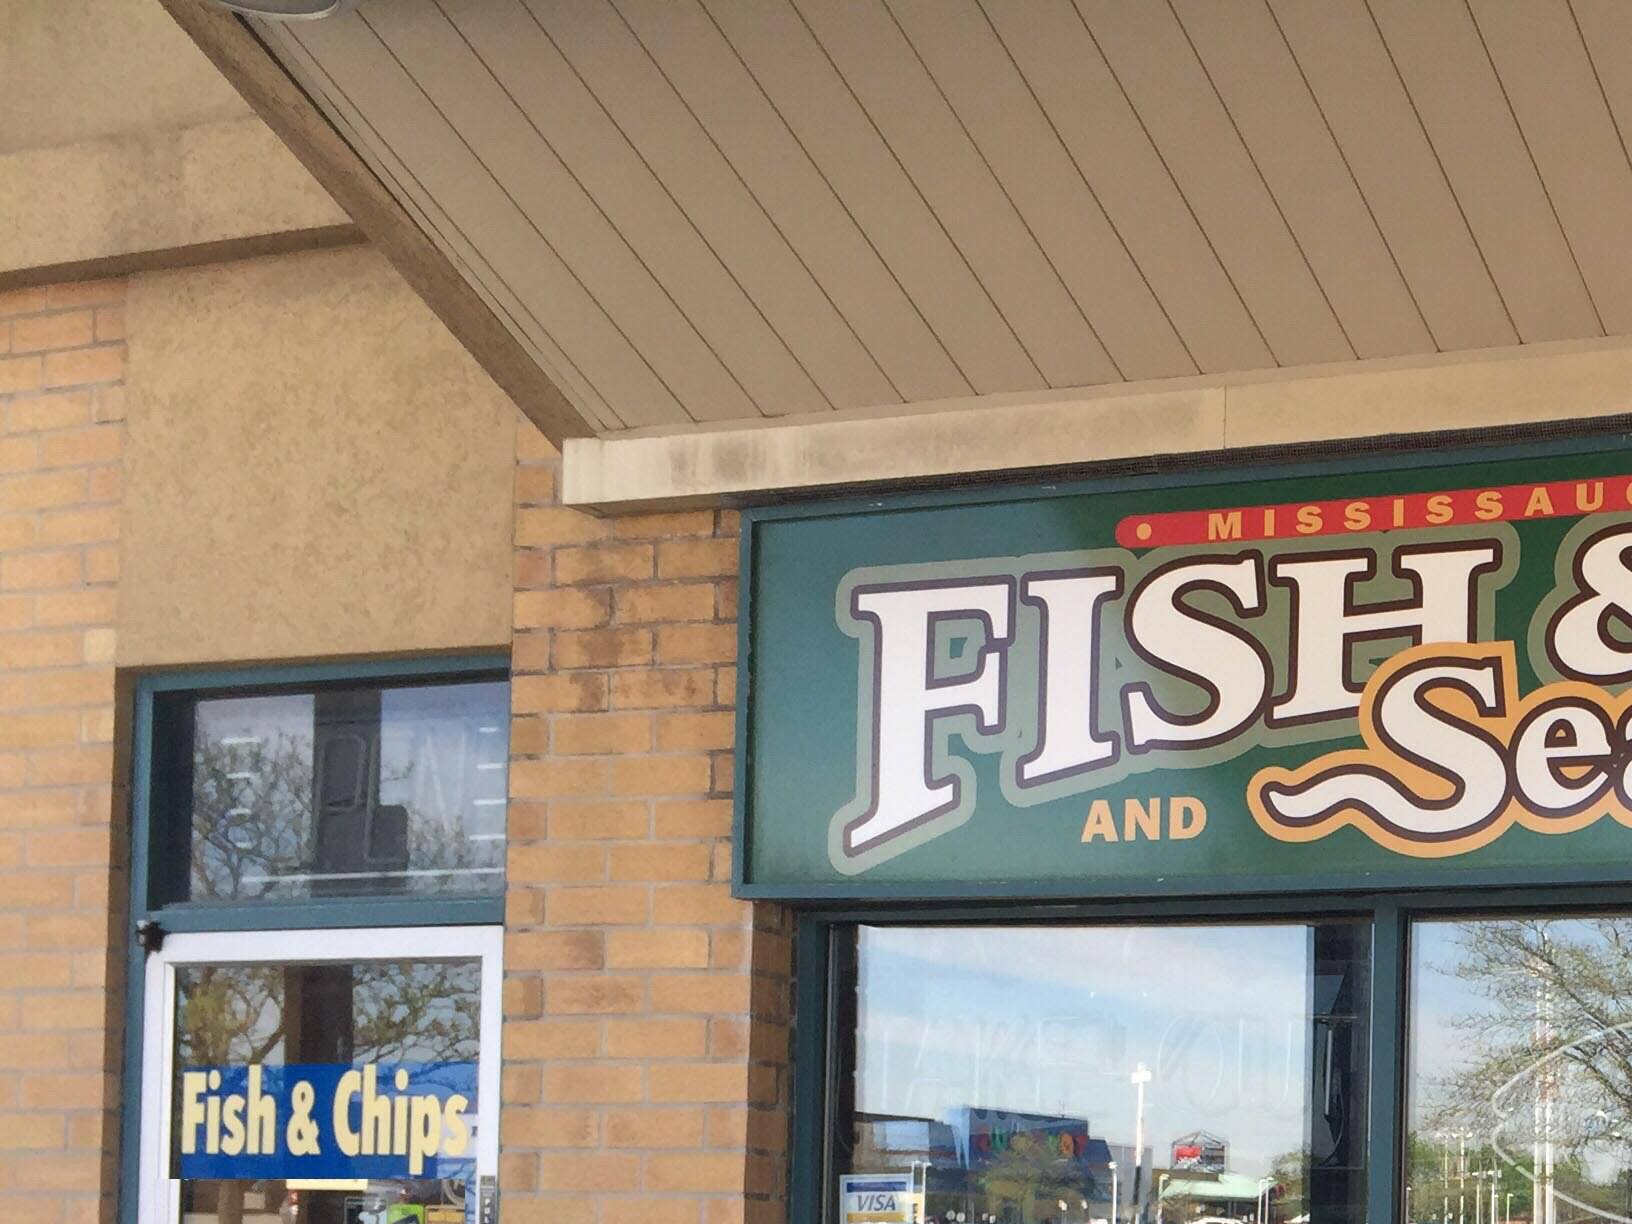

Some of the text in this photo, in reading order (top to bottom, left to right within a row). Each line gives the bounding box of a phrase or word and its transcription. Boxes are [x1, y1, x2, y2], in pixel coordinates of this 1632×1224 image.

[842, 536, 1502, 858] FISH
[1080, 796, 1208, 844] AND
[180, 1062, 469, 1177] Fish & Chips
[857, 1194, 897, 1212] VISA
